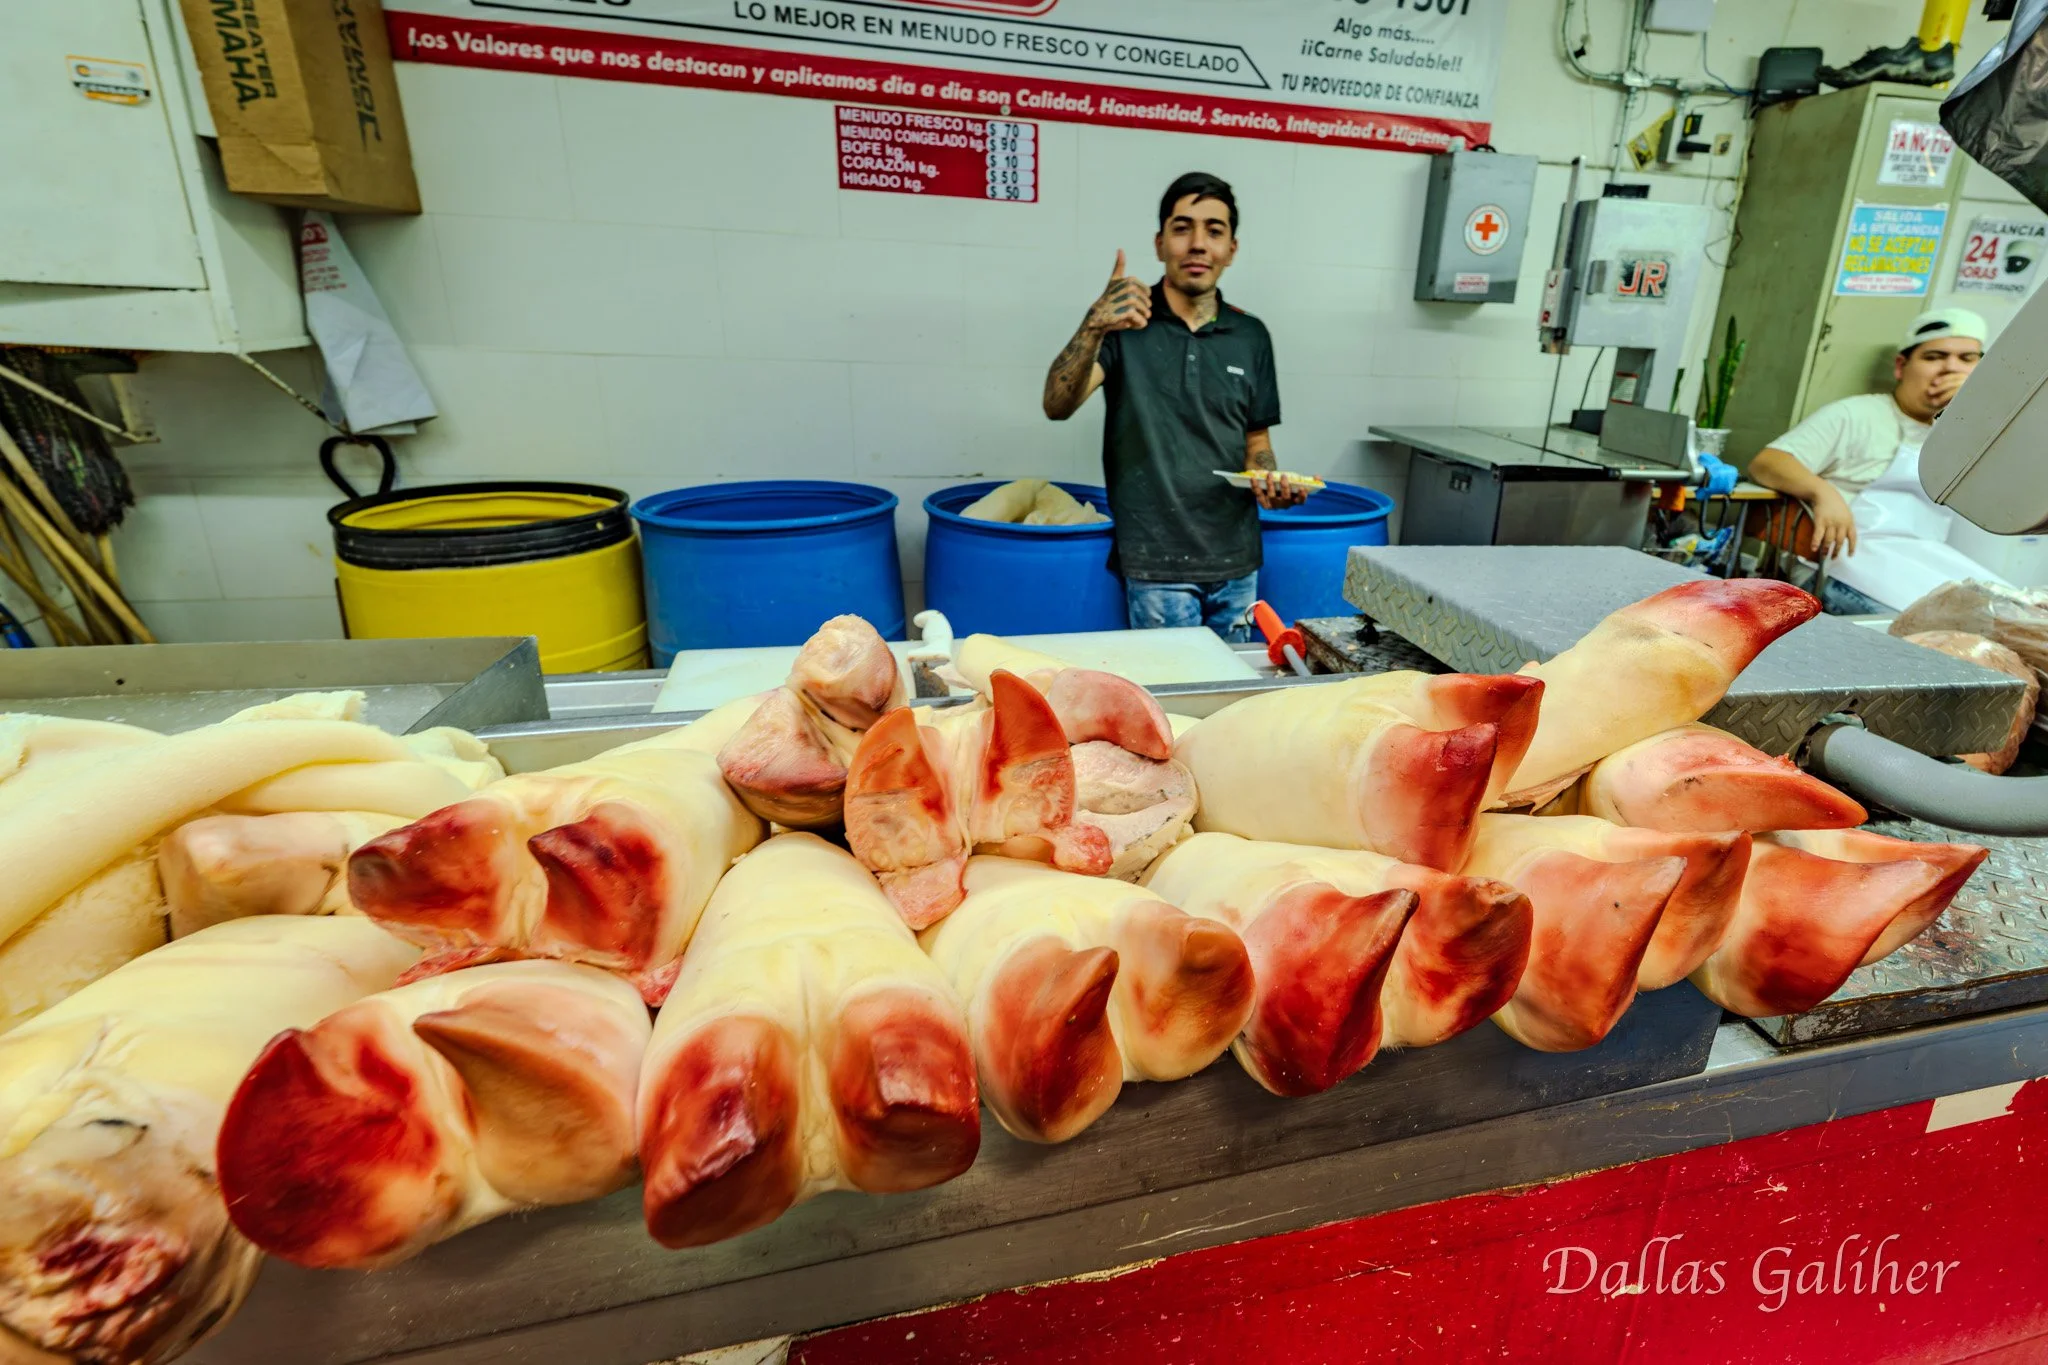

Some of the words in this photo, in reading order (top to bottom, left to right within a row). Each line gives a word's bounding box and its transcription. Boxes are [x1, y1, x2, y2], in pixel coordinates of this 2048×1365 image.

[734, 1, 766, 22] LO
[774, 3, 856, 32] MEJOR
[863, 16, 894, 36] EN
[901, 21, 997, 47] MENUDO
[1003, 32, 1089, 58] FRESCO
[1094, 43, 1108, 59] Y
[1113, 45, 1240, 73] CONGELADO
[1333, 17, 1372, 39] Algo
[1368, 47, 1463, 72] Saludable!!
[408, 27, 448, 50] Los
[452, 30, 545, 60] Valores
[550, 46, 595, 66] que
[601, 51, 641, 69] nos
[647, 51, 747, 79] destacan
[752, 65, 765, 84] y
[770, 65, 877, 94] aplicamos
[920, 81, 936, 98] a
[977, 88, 1011, 106] son
[1016, 88, 1095, 116] Calidad,
[1100, 98, 1206, 126] Honestidad,
[1210, 108, 1281, 133] Servicio,
[1286, 116, 1373, 143] Integridad
[1376, 127, 1387, 140] e
[1389, 125, 1450, 147] Higiene
[1281, 73, 1299, 91] TU
[1302, 75, 1381, 100] PROVEEDOR
[1385, 85, 1402, 101] DE
[1405, 86, 1480, 109] CONFIANZA
[839, 108, 902, 126] MENUDO
[905, 114, 963, 131] FRESCO
[1005, 124, 1019, 136] 70
[840, 125, 892, 141] MENUDO
[894, 132, 968, 148] CONGELADO
[1002, 138, 1017, 152] 90
[840, 140, 882, 155] BOFE
[1005, 156, 1018, 168] 10
[843, 172, 901, 188] HIGADO
[1005, 186, 1019, 199] 50
[1002, 171, 1018, 184] 50
[1849, 235, 1866, 252] NO
[1867, 235, 1884, 253] SE
[1884, 236, 1936, 254] ACEPTAN
[1965, 235, 2000, 263] 24
[1617, 259, 1669, 297] JR
